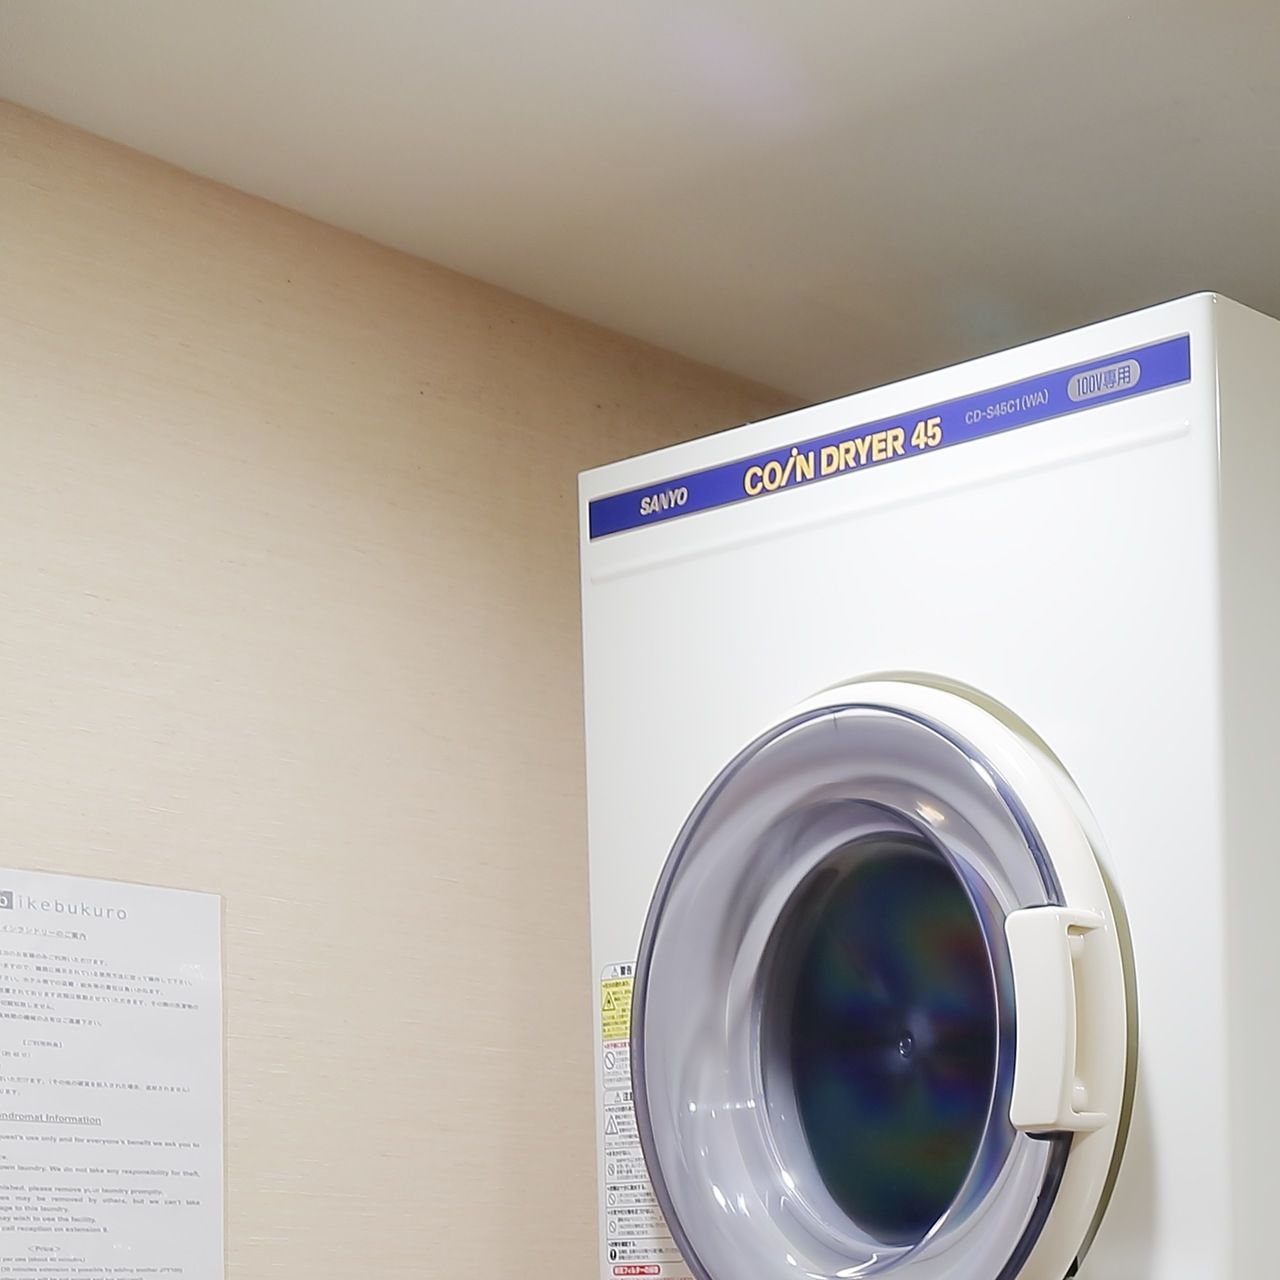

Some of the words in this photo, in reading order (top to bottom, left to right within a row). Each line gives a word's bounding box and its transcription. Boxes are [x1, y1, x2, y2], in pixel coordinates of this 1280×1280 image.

[1076, 365, 1131, 397] 100V専用
[965, 389, 1049, 424] CD-S45C1(WA)
[820, 427, 905, 476] DRYER
[910, 417, 943, 449] 45
[640, 487, 688, 515] SANYO
[18, 895, 128, 920] ikebukuro
[45, 1113, 101, 1126] Information
